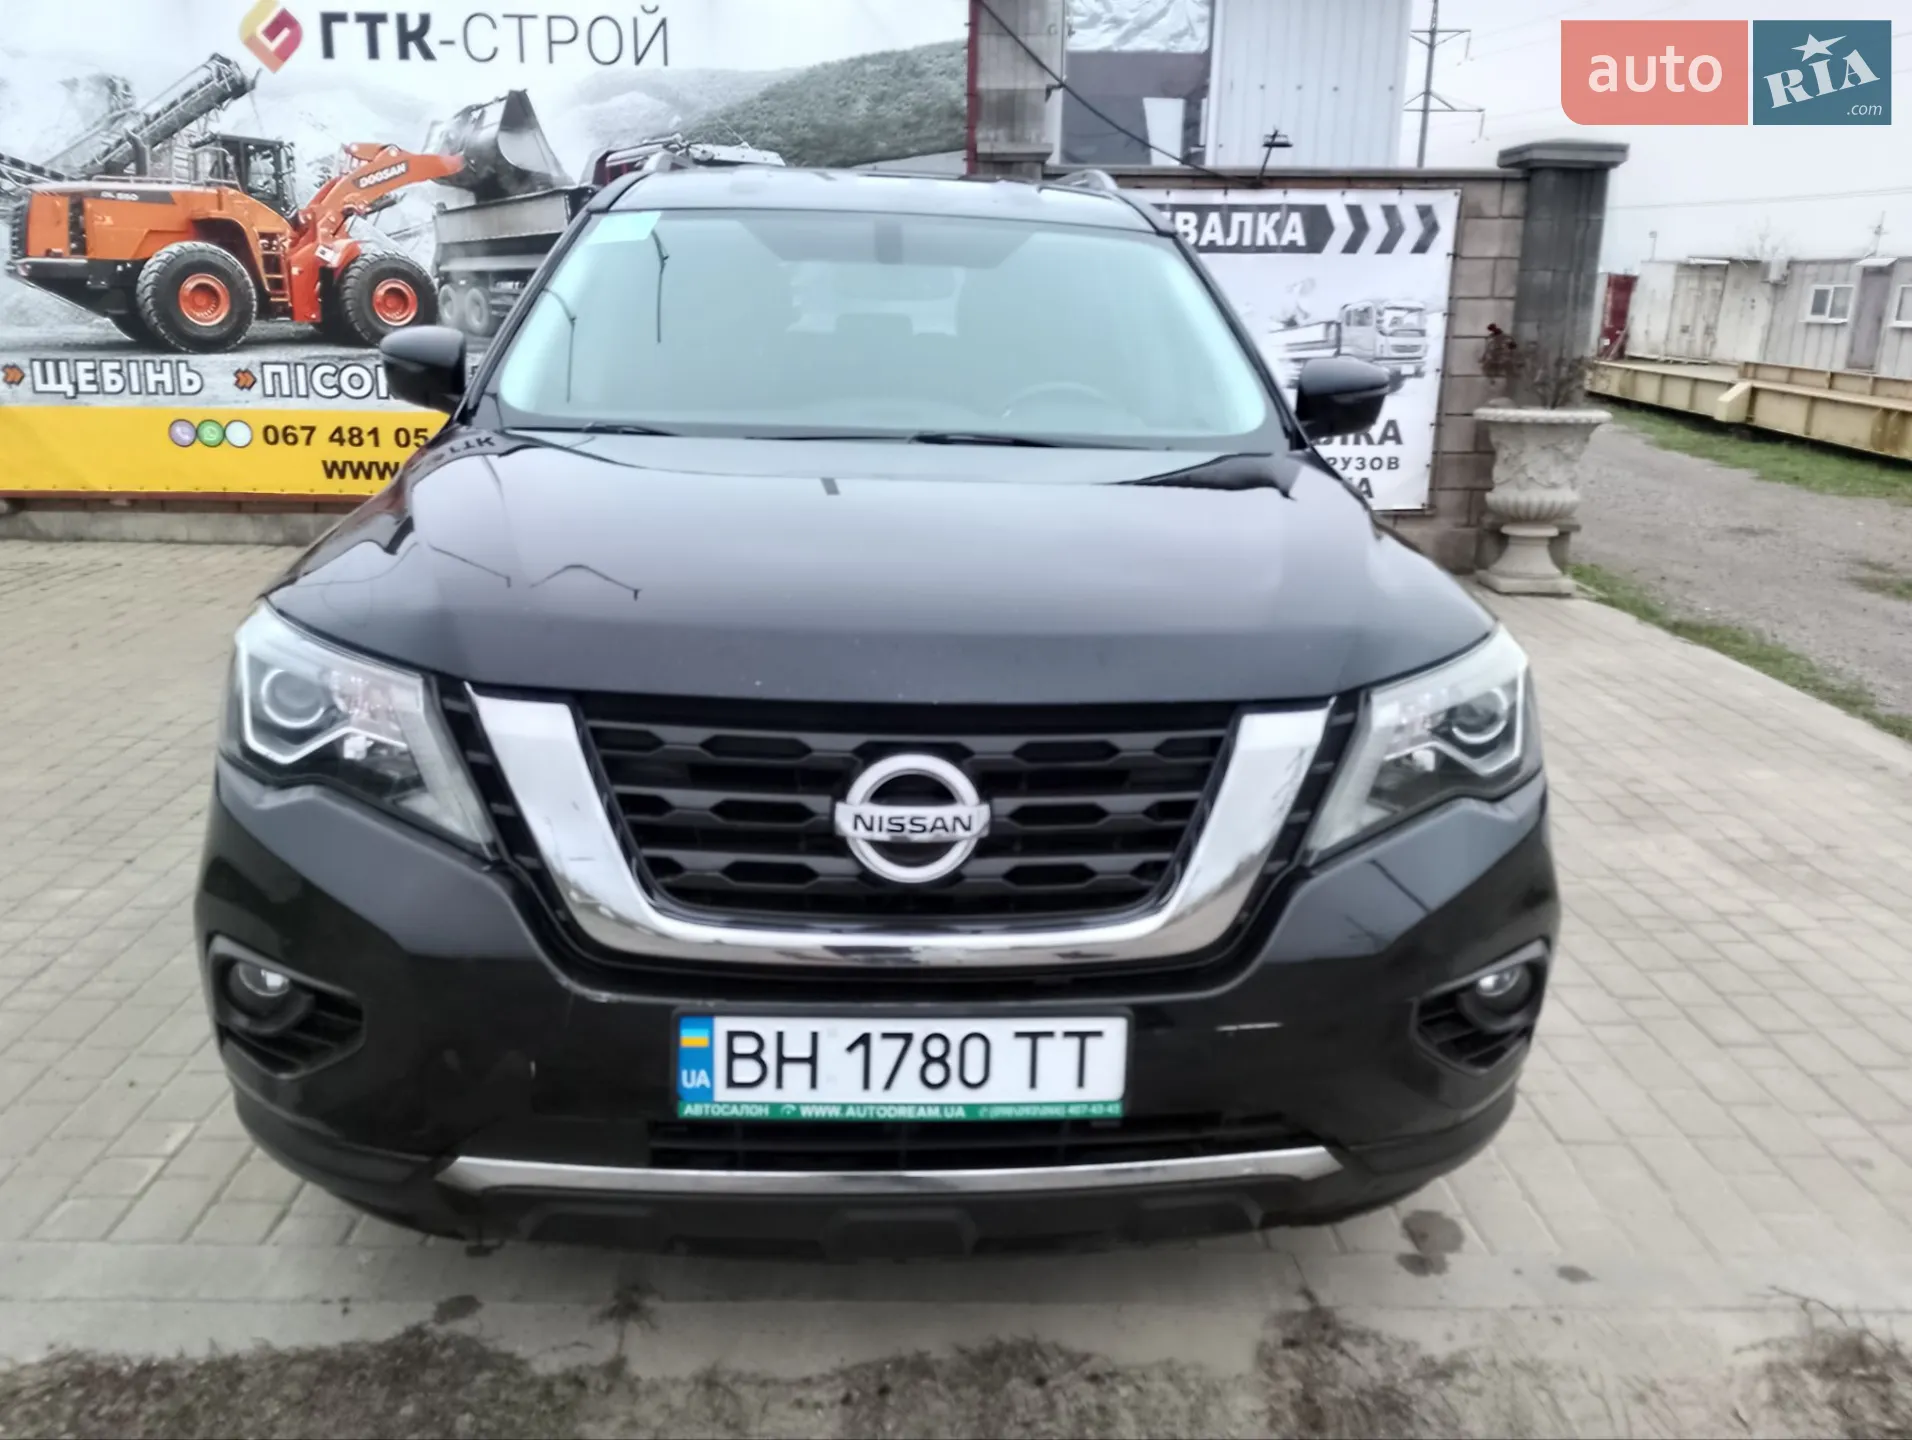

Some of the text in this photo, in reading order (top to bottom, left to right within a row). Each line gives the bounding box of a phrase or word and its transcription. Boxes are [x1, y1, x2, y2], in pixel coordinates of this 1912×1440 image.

[319, 4, 669, 67] ГТК-СТРОЙ
[1160, 210, 1307, 247] ВАЛКА
[31, 358, 204, 399] ЩЕБІНЬ
[262, 425, 429, 448] 067 481 05
[853, 814, 973, 834] NISSAN
[726, 1030, 1104, 1091] BH 1780 TT
[681, 1069, 711, 1089] UA
[683, 1103, 770, 1118] АВТОСАЛОН
